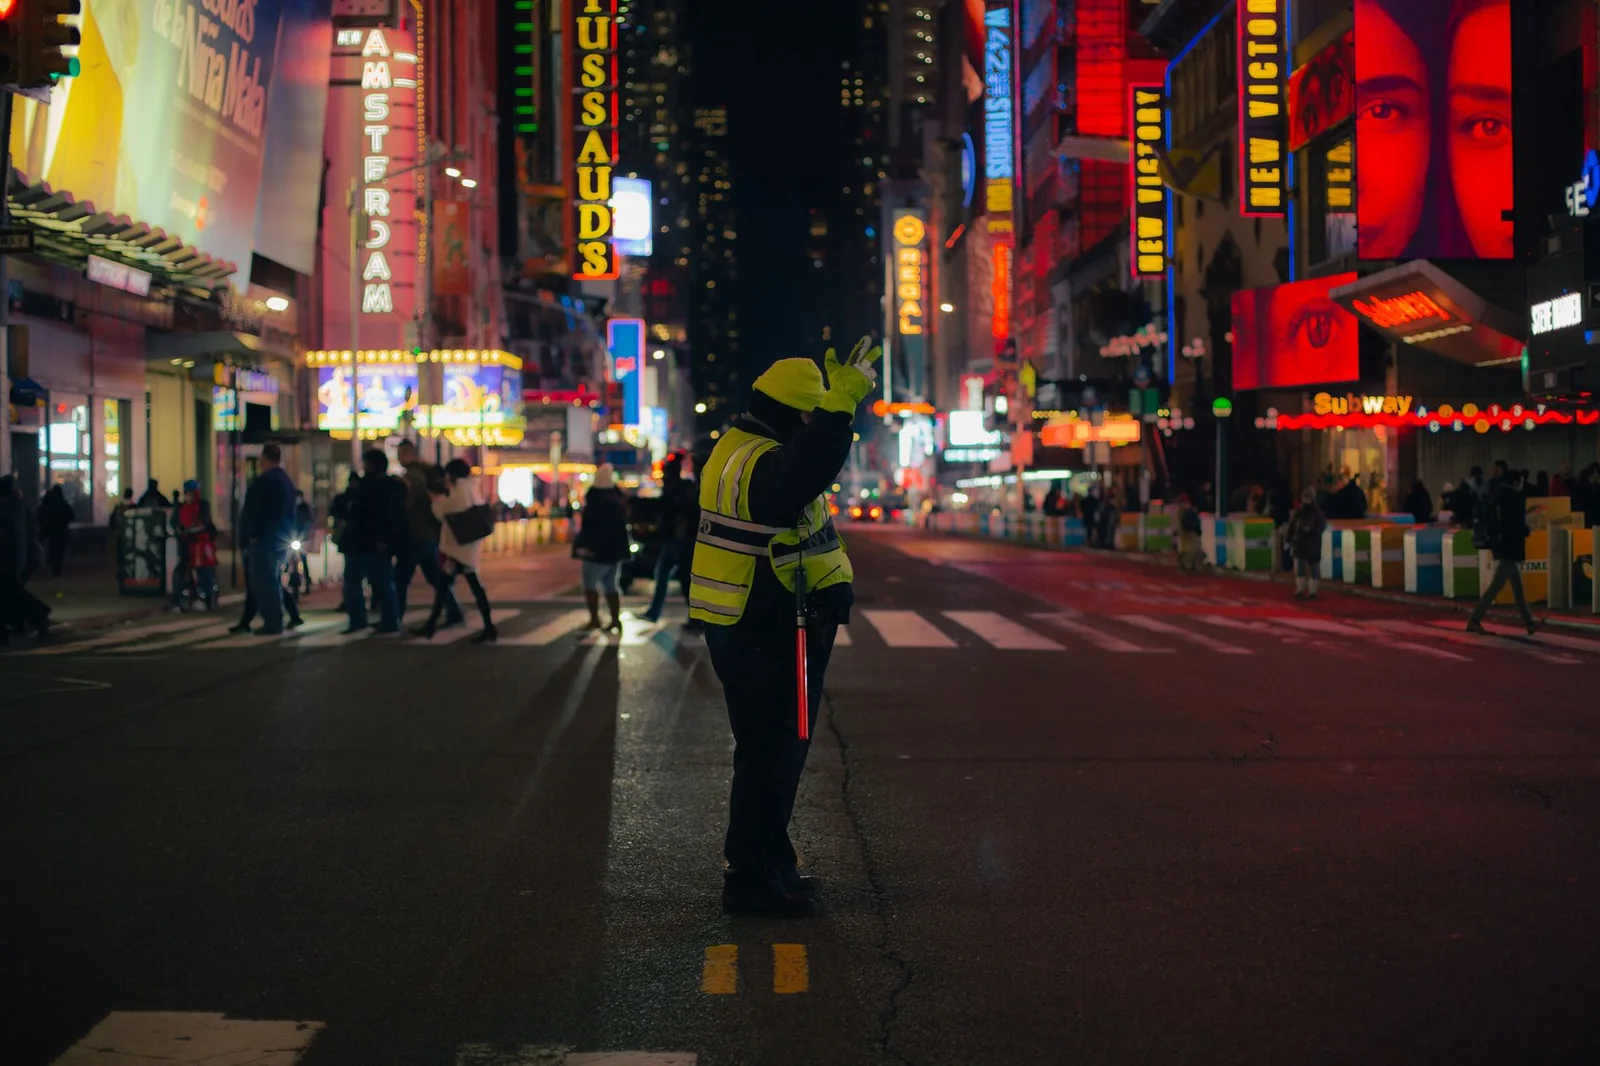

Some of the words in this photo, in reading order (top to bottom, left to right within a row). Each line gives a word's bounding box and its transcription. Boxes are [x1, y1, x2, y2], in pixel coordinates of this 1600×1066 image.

[222, 41, 265, 139] Mala
[337, 30, 363, 45] NEW
[362, 29, 393, 313] AMSTERDAM
[1136, 91, 1163, 203] VICTORY
[1249, 138, 1281, 207] NEW
[1137, 216, 1164, 272] NEW
[1314, 392, 1413, 417] Subway
[1537, 404, 1547, 416] 7
